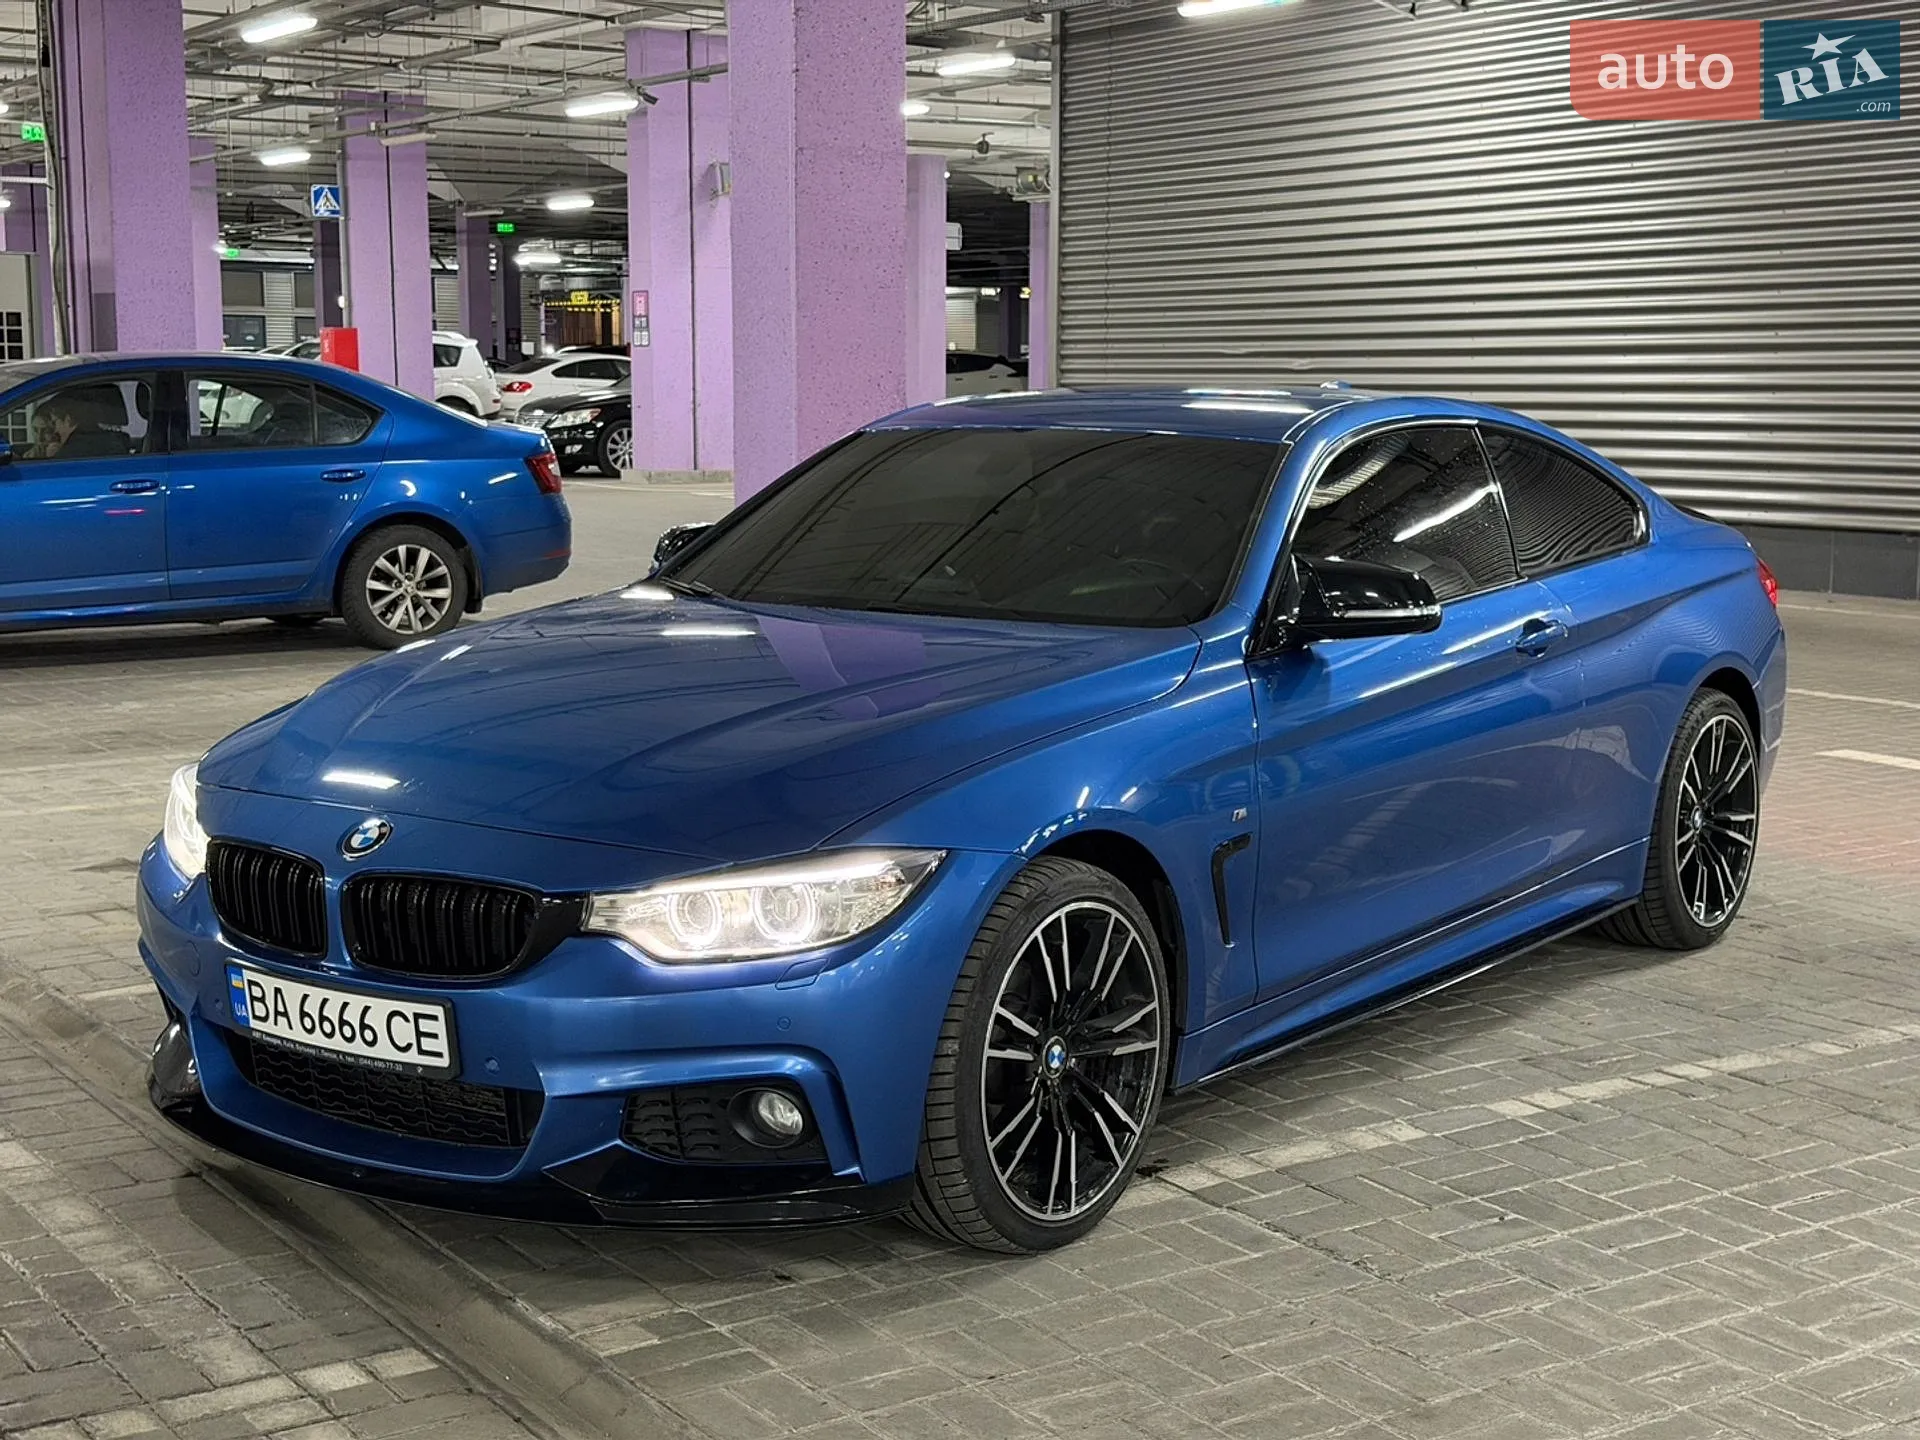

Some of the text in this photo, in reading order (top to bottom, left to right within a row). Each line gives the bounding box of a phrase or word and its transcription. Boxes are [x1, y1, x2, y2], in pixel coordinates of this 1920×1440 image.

[234, 1002, 248, 1017] UA
[247, 979, 293, 1030] BA
[299, 993, 378, 1047] 6666
[386, 1010, 443, 1058] CE
